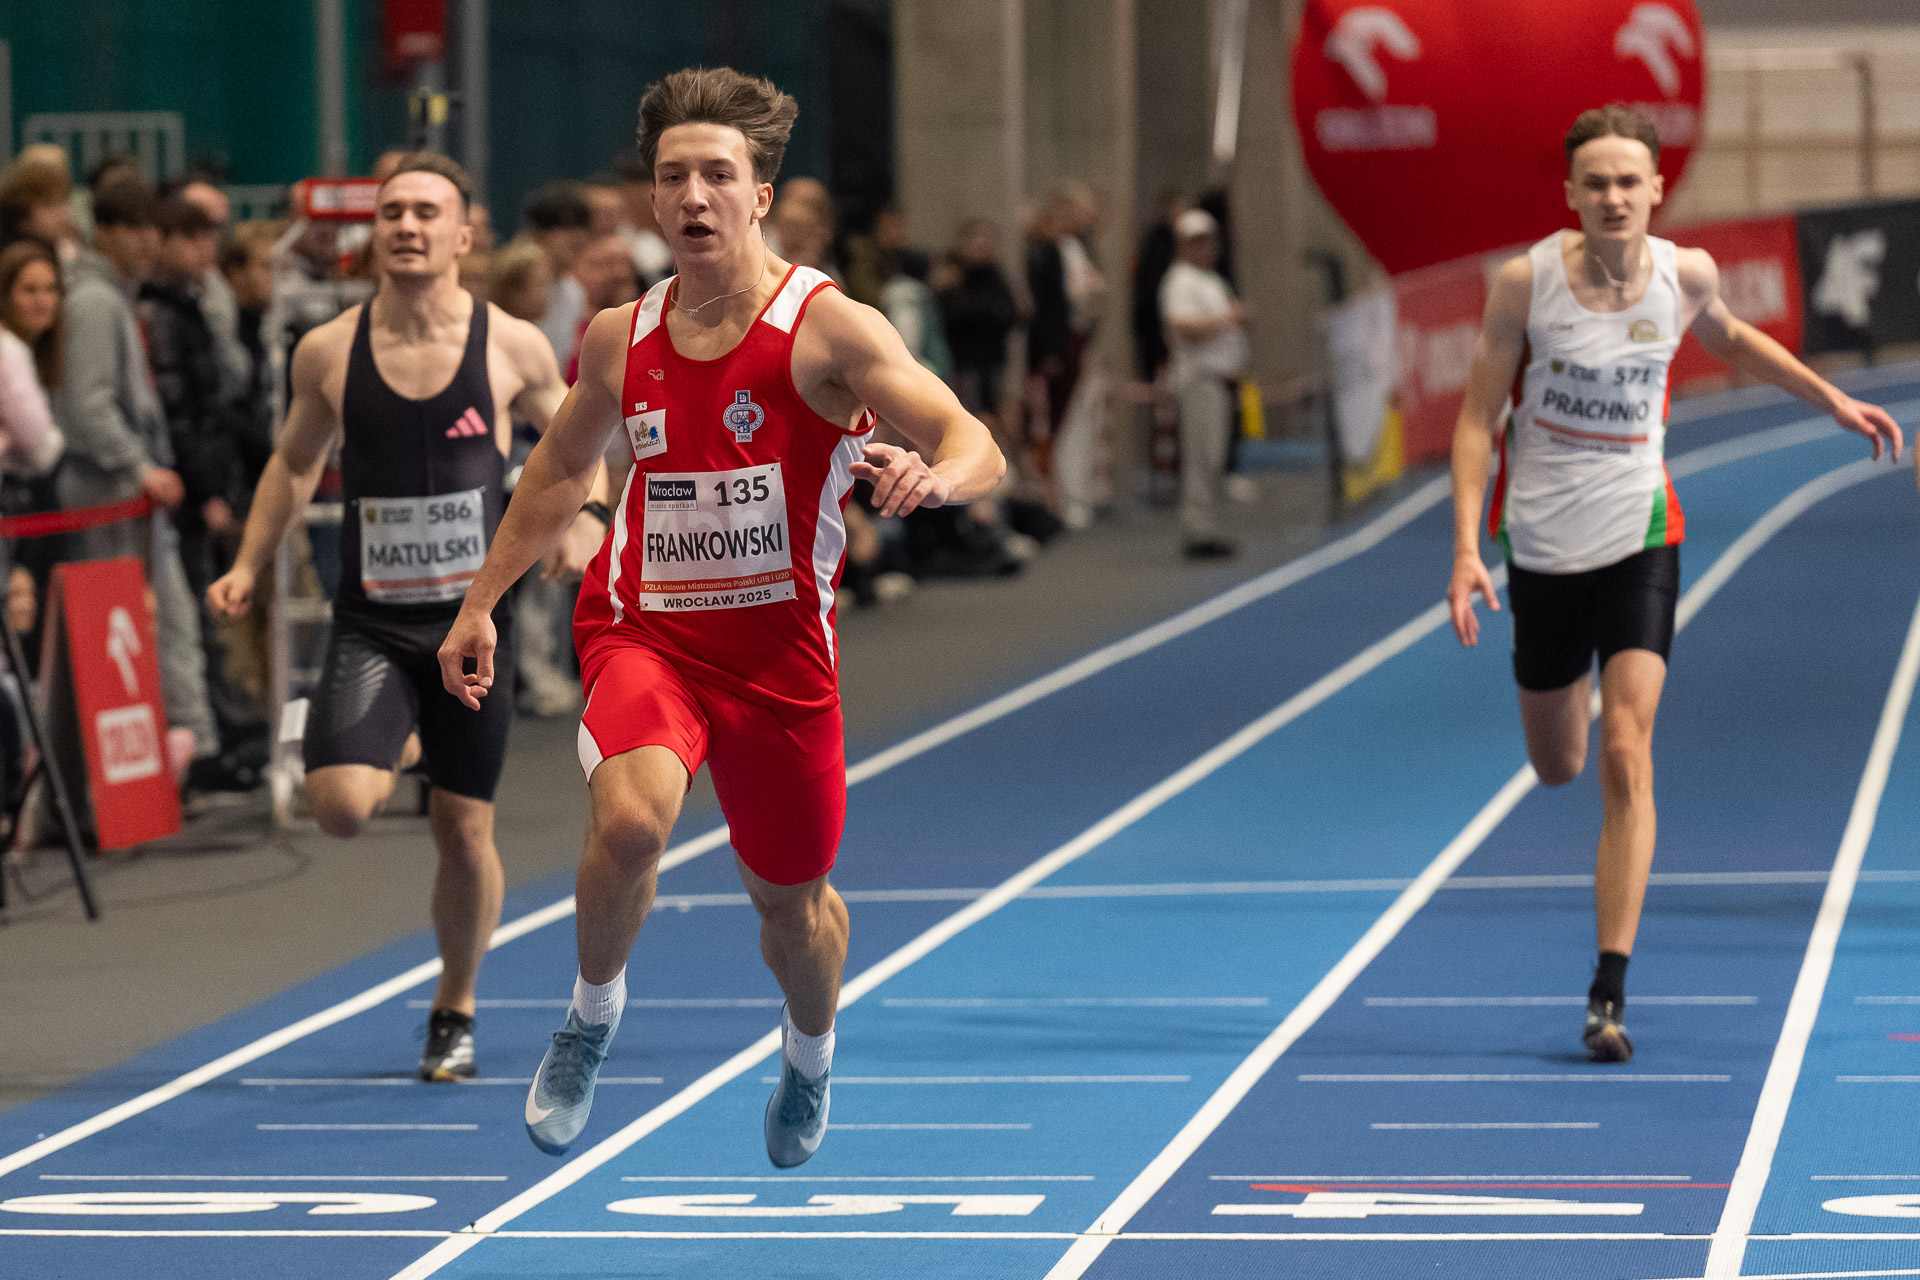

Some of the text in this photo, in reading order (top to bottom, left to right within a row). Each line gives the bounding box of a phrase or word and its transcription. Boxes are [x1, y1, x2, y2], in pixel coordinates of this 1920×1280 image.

[1613, 366, 1650, 386] 571
[635, 401, 648, 412] BKS
[1542, 386, 1650, 421] PRACHNIO
[650, 483, 693, 497] Wrocław
[713, 475, 770, 507] 135
[427, 501, 472, 524] 586
[668, 501, 695, 510] spotkań
[368, 535, 479, 567] MATULSKI
[647, 522, 783, 562] FRANKOWSKI
[687, 581, 732, 590] Mistrzostwa
[733, 577, 756, 588] Polski
[757, 574, 770, 584] U18
[775, 571, 790, 581] U20
[663, 589, 772, 608] WROCŁAW 2025
[606, 1193, 1047, 1217] 5
[1211, 1191, 1645, 1218] 4
